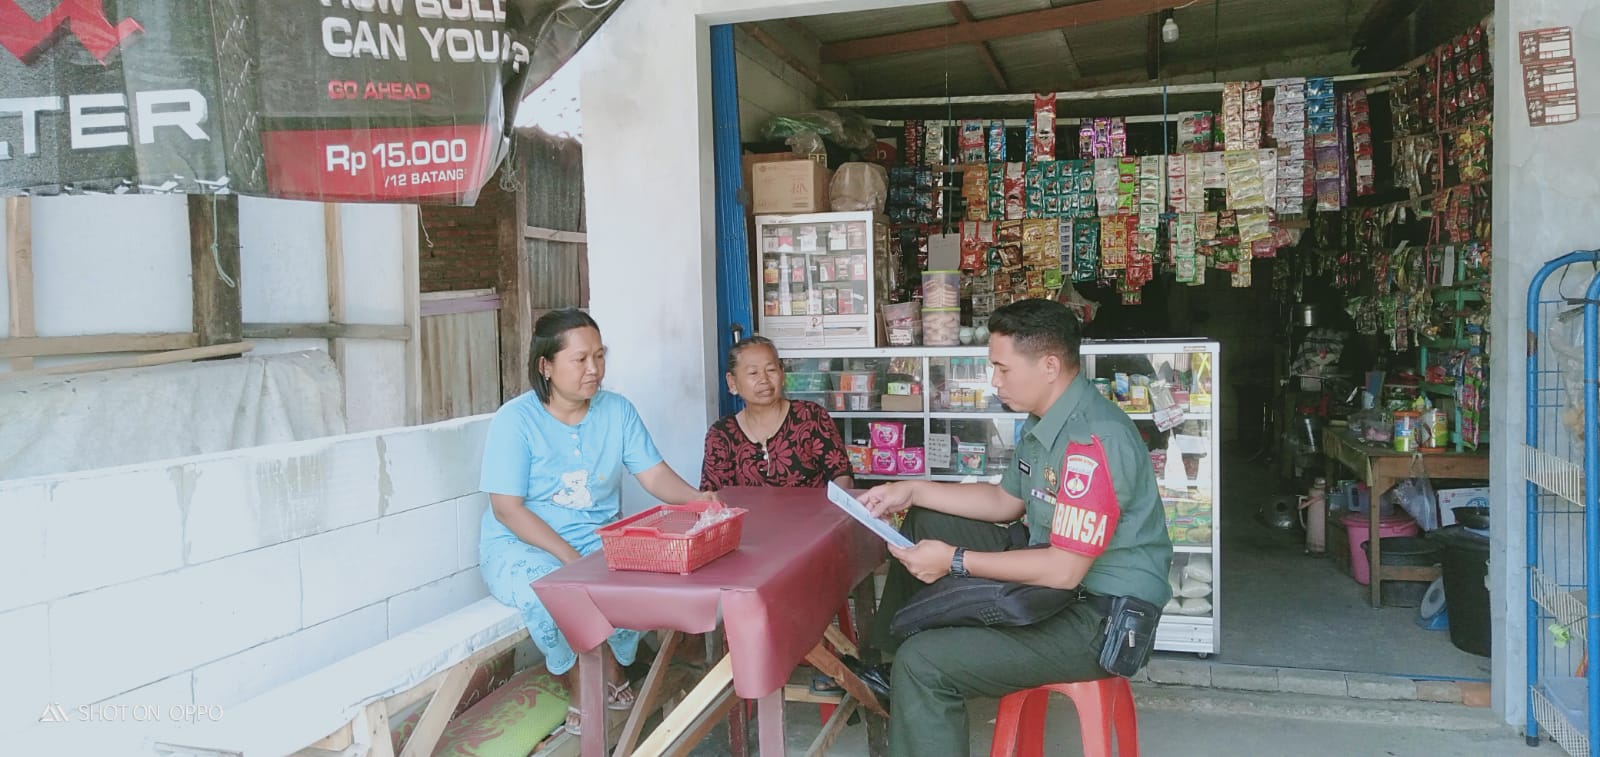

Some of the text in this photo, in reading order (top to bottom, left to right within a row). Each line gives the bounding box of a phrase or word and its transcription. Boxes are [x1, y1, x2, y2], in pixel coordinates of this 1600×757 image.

[321, 16, 407, 61] CAN
[328, 80, 432, 100] GO AHEAD
[0, 88, 210, 160] TER
[326, 138, 467, 176] Rp 15.000
[384, 168, 464, 188] /12 BATANG
